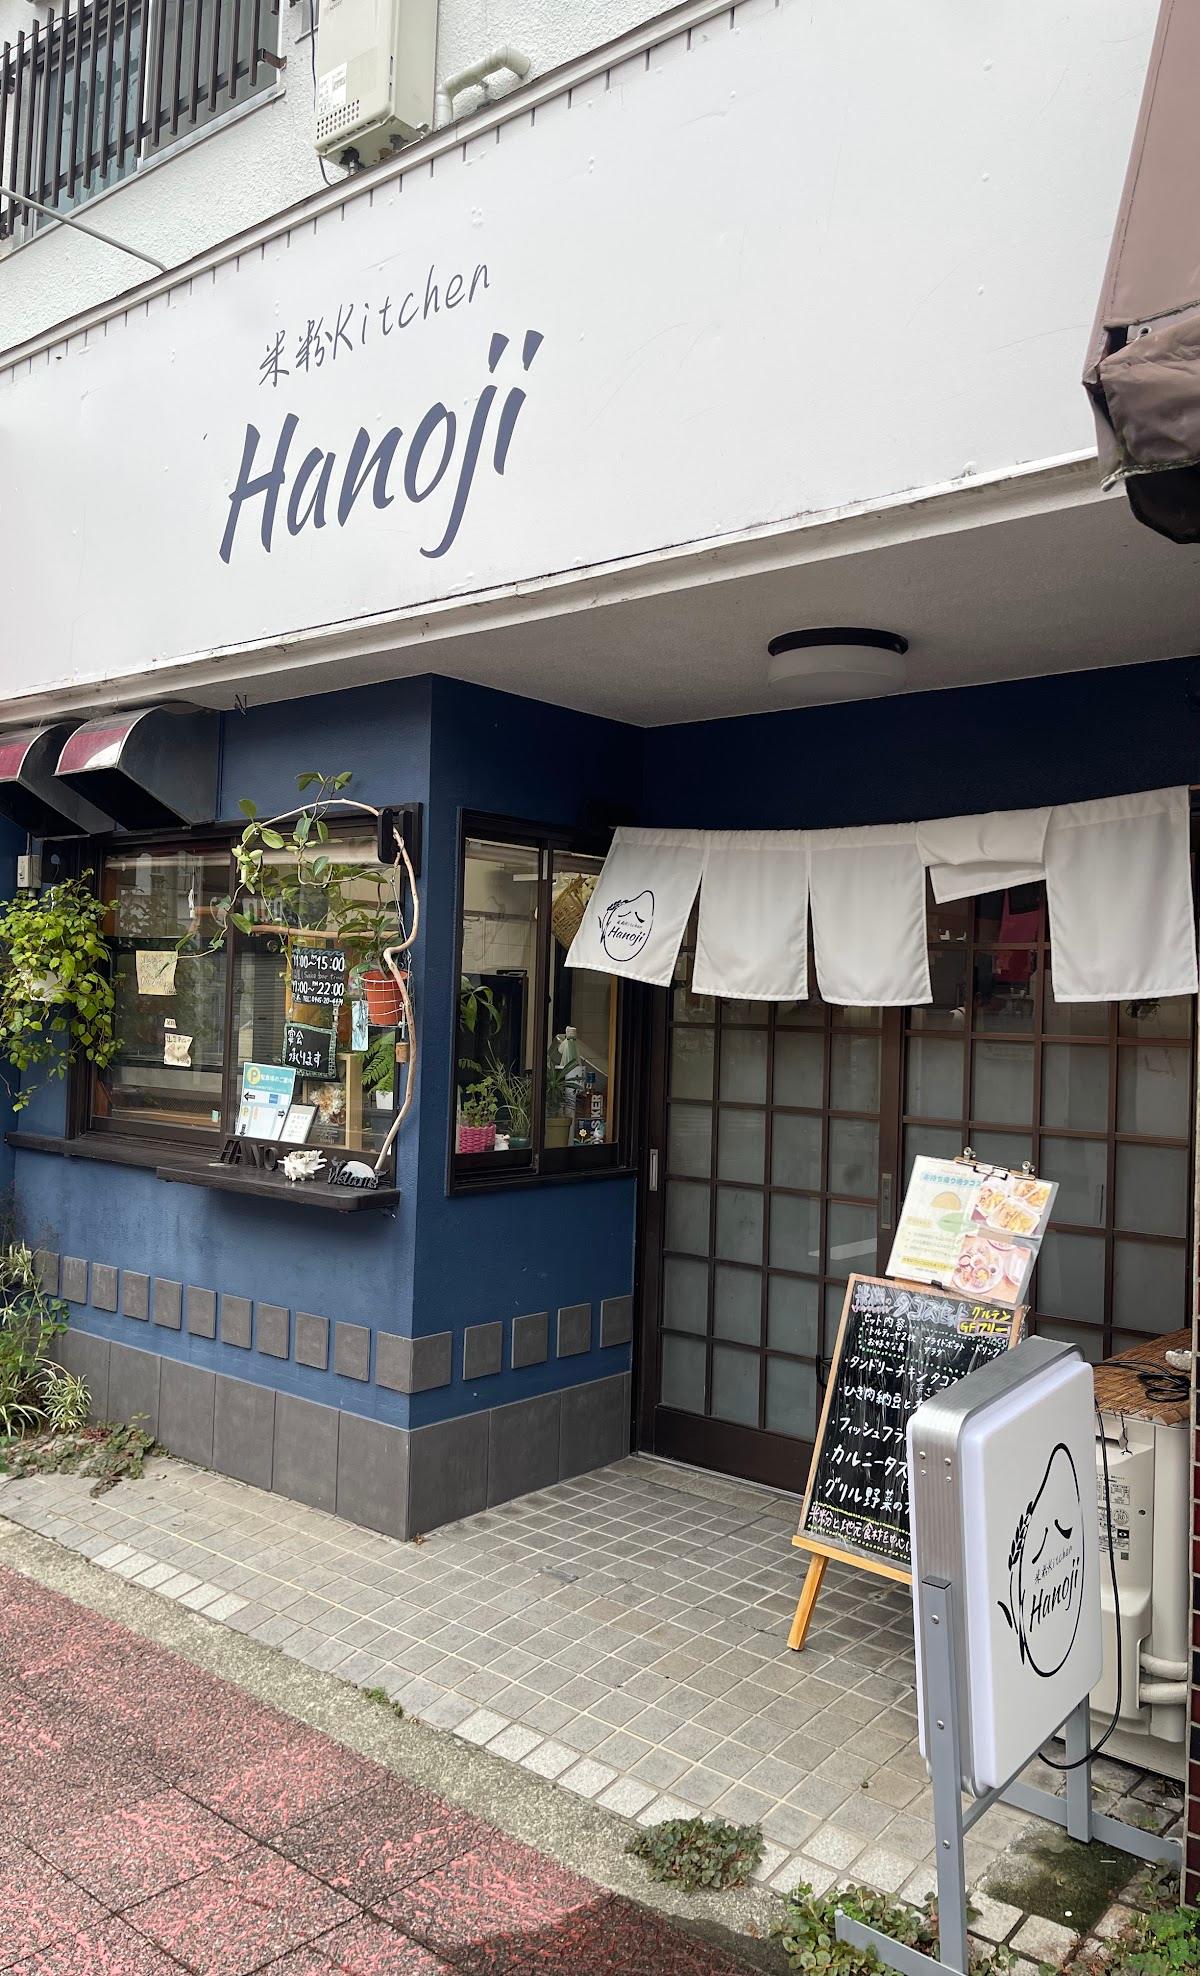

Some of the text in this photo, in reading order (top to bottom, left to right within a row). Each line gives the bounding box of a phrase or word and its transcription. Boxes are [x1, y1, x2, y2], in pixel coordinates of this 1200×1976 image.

[219, 329, 544, 564] Hanoji
[607, 926, 646, 947] Hanoji
[287, 1027, 304, 1047] 宴会
[288, 1047, 322, 1069] 承ります
[328, 1165, 380, 1191] Welcome
[864, 1313, 906, 1332] セット内容
[971, 1306, 1012, 1322] グルテン
[979, 1322, 1008, 1335] フリー
[831, 1443, 908, 1479] カルニータス
[1029, 1556, 1080, 1632] Hanoji
